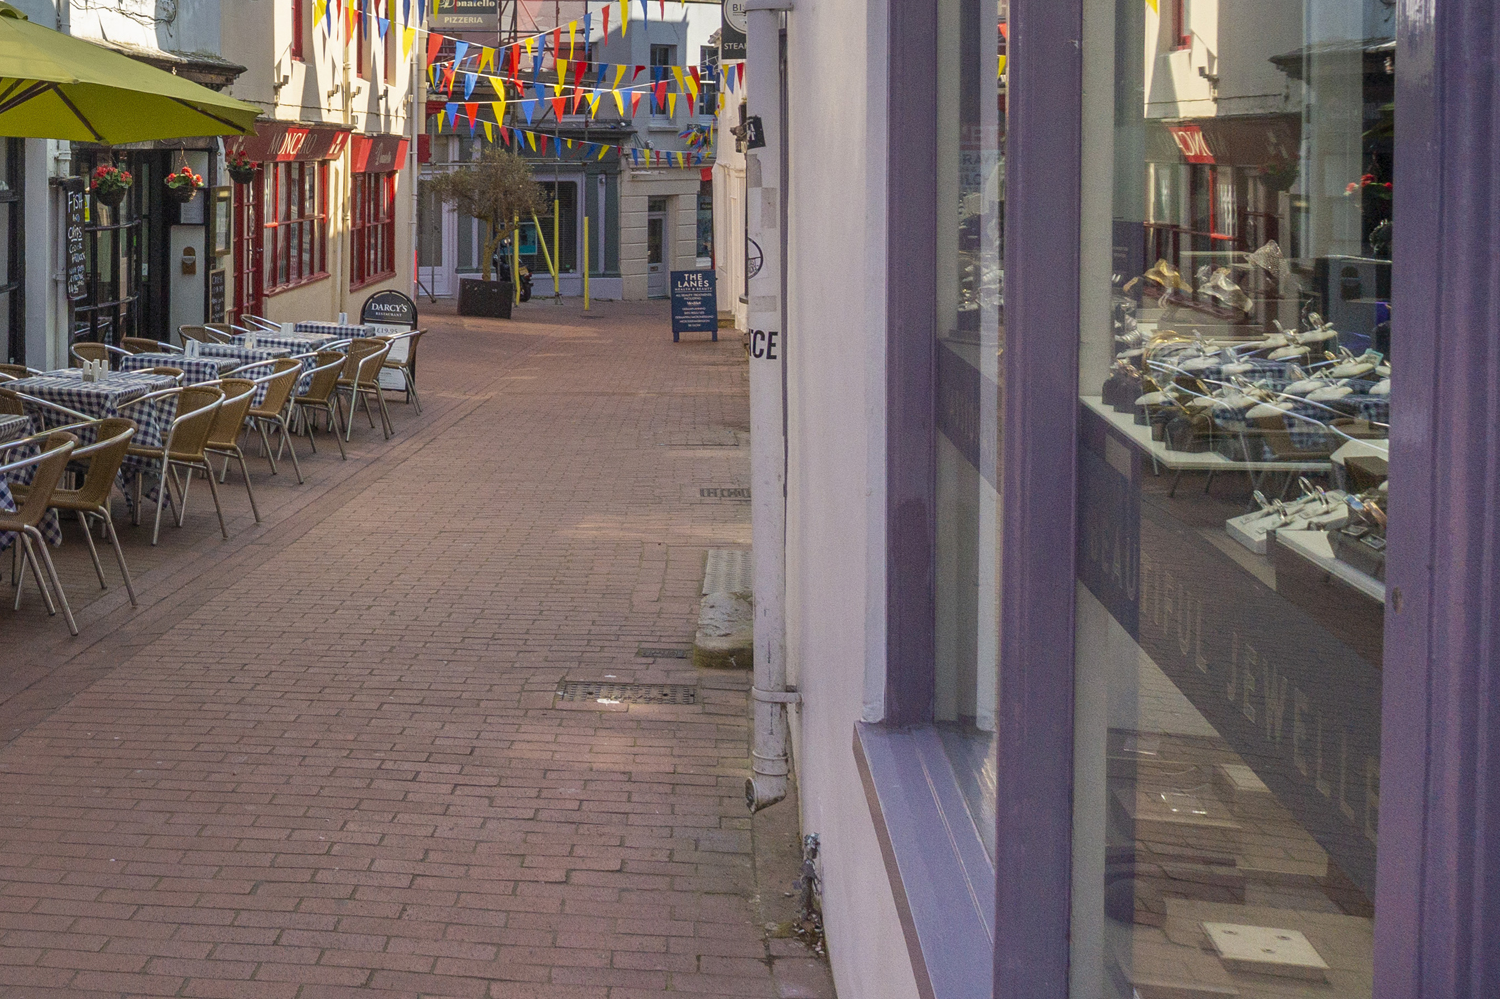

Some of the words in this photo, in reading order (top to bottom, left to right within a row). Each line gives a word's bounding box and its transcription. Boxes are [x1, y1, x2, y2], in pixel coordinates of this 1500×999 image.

[267, 133, 318, 155] MONCARO
[678, 280, 710, 288] LANES
[372, 303, 407, 312] DARCY'S
